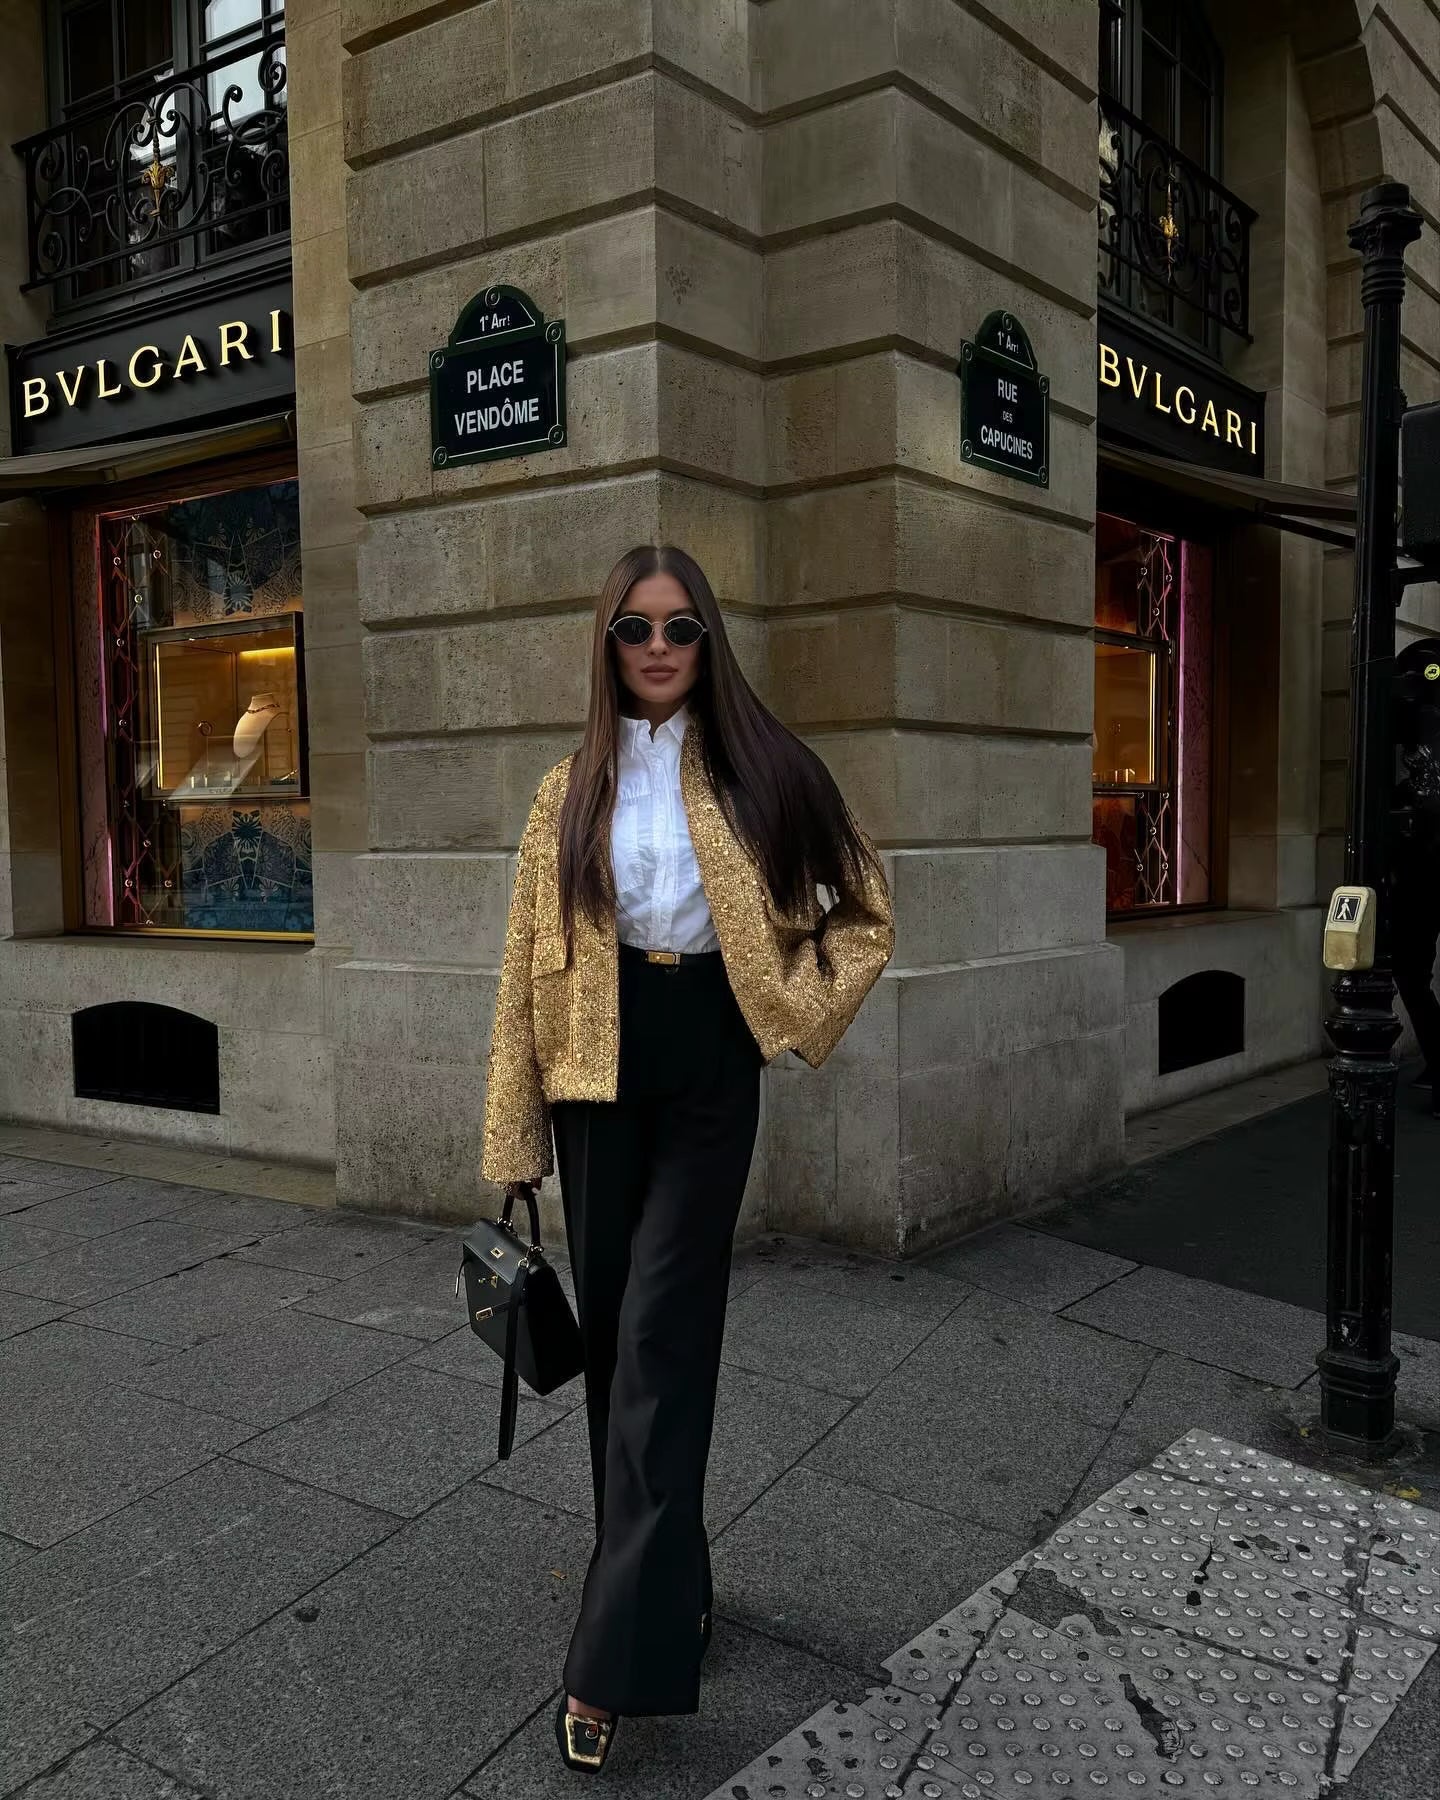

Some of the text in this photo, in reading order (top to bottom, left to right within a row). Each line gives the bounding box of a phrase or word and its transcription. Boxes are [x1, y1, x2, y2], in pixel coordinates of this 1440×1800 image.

[22, 309, 282, 418] BVLGARI
[466, 359, 525, 394] PLACE
[997, 378, 1018, 404] RUE
[1099, 343, 1257, 455] BVLGARI
[454, 397, 540, 436] VENDÔME
[1002, 410, 1013, 423] DES
[980, 424, 1033, 460] CAPUCINES
